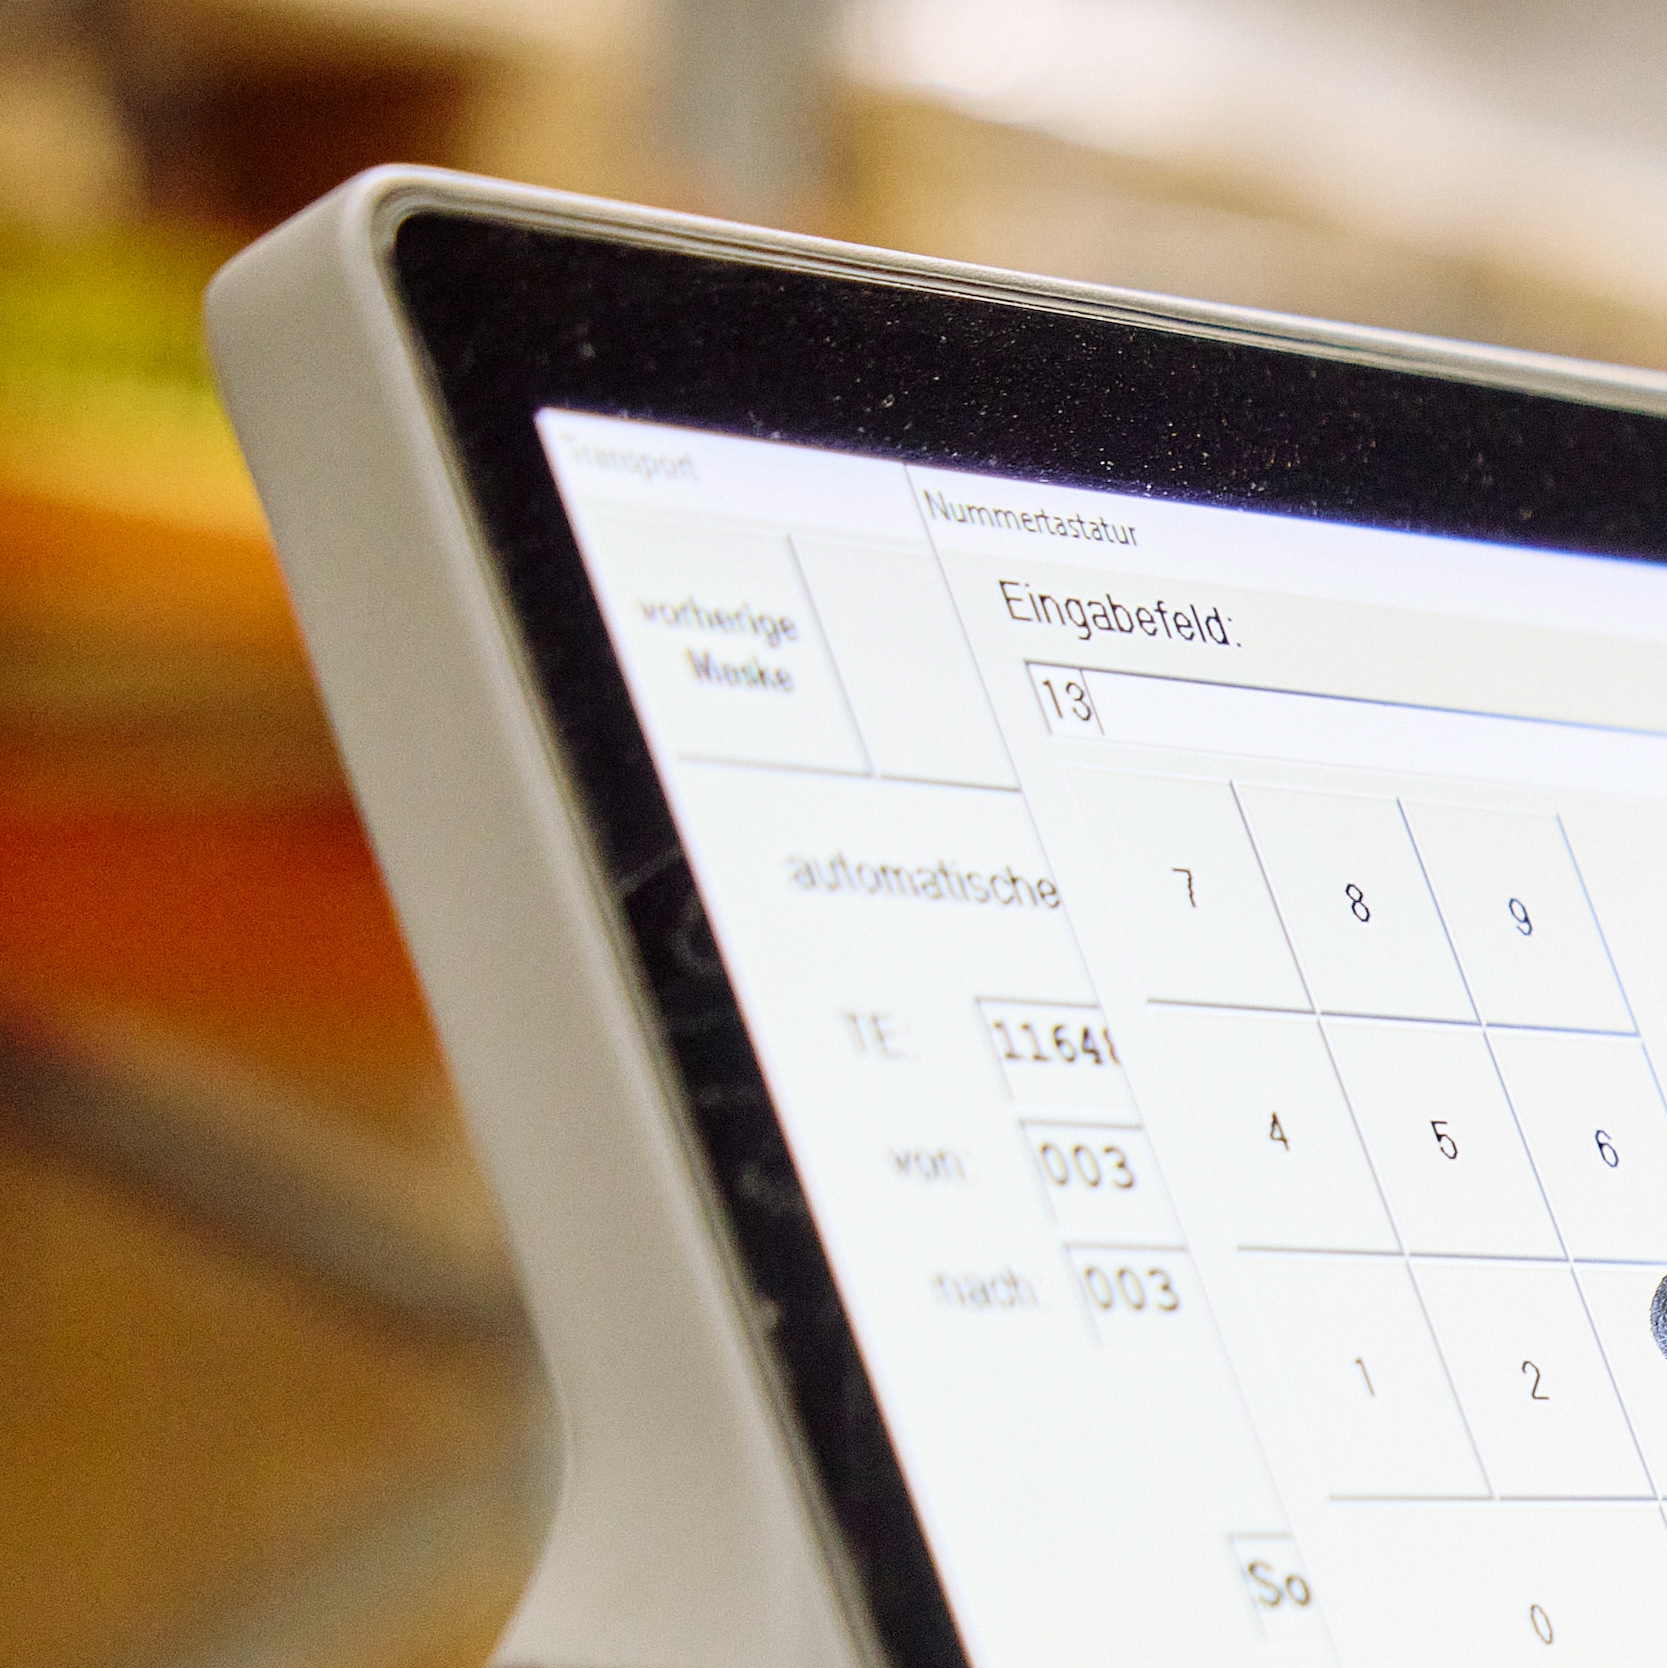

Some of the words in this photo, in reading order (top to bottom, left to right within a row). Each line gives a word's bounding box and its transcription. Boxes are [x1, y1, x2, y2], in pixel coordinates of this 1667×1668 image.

[924, 489, 1139, 549] Nummertastatur
[638, 596, 799, 646] vorherige
[998, 579, 1242, 648] Eingabefeld:
[686, 649, 794, 694] Maske
[1041, 679, 1092, 724] 13
[787, 852, 1061, 909] automatische
[1172, 867, 1196, 908] 7
[1345, 884, 1371, 923] 8
[1509, 898, 1533, 936] 9
[1269, 1112, 1290, 1152] 4
[1431, 1120, 1459, 1160] 5
[1595, 1130, 1619, 1168] 6
[1039, 1141, 1136, 1190] 003
[1083, 1264, 1181, 1313] 003
[1353, 1357, 1376, 1397] 1
[1521, 1360, 1549, 1401] 2
[1246, 1560, 1311, 1608] So
[1529, 1603, 1554, 1645] 0
